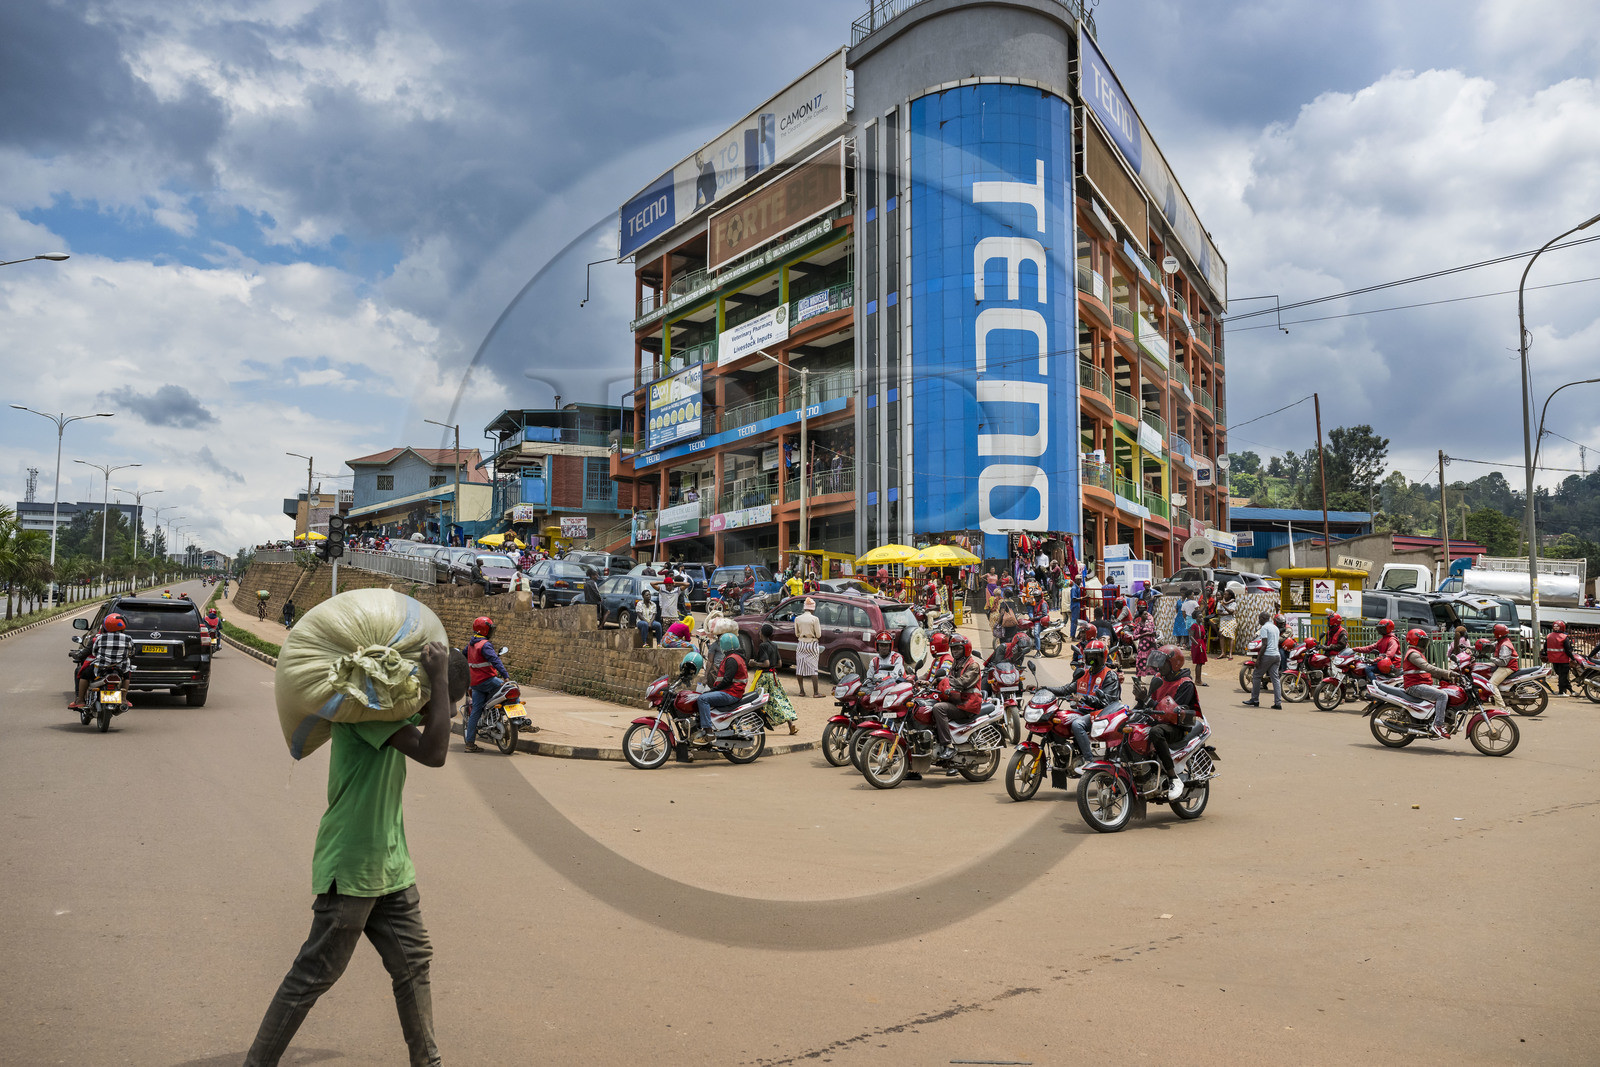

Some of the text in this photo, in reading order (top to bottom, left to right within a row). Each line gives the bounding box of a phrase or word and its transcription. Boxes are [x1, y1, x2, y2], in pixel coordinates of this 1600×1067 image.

[779, 93, 823, 131] CAMON 17
[1091, 61, 1133, 143] TECNO
[719, 141, 739, 170] TO
[717, 164, 739, 190] OUT
[627, 195, 668, 238] TECNO
[731, 328, 752, 343] Veterinary
[752, 319, 773, 333] Pharmacy
[733, 332, 773, 354] Livestock Inputs
[972, 159, 1049, 536] TECNO
[738, 424, 757, 437] TECNO
[688, 440, 706, 451] TECNO
[646, 453, 660, 464] TECNO
[1343, 558, 1354, 566] KN
[1355, 560, 1362, 568] 91
